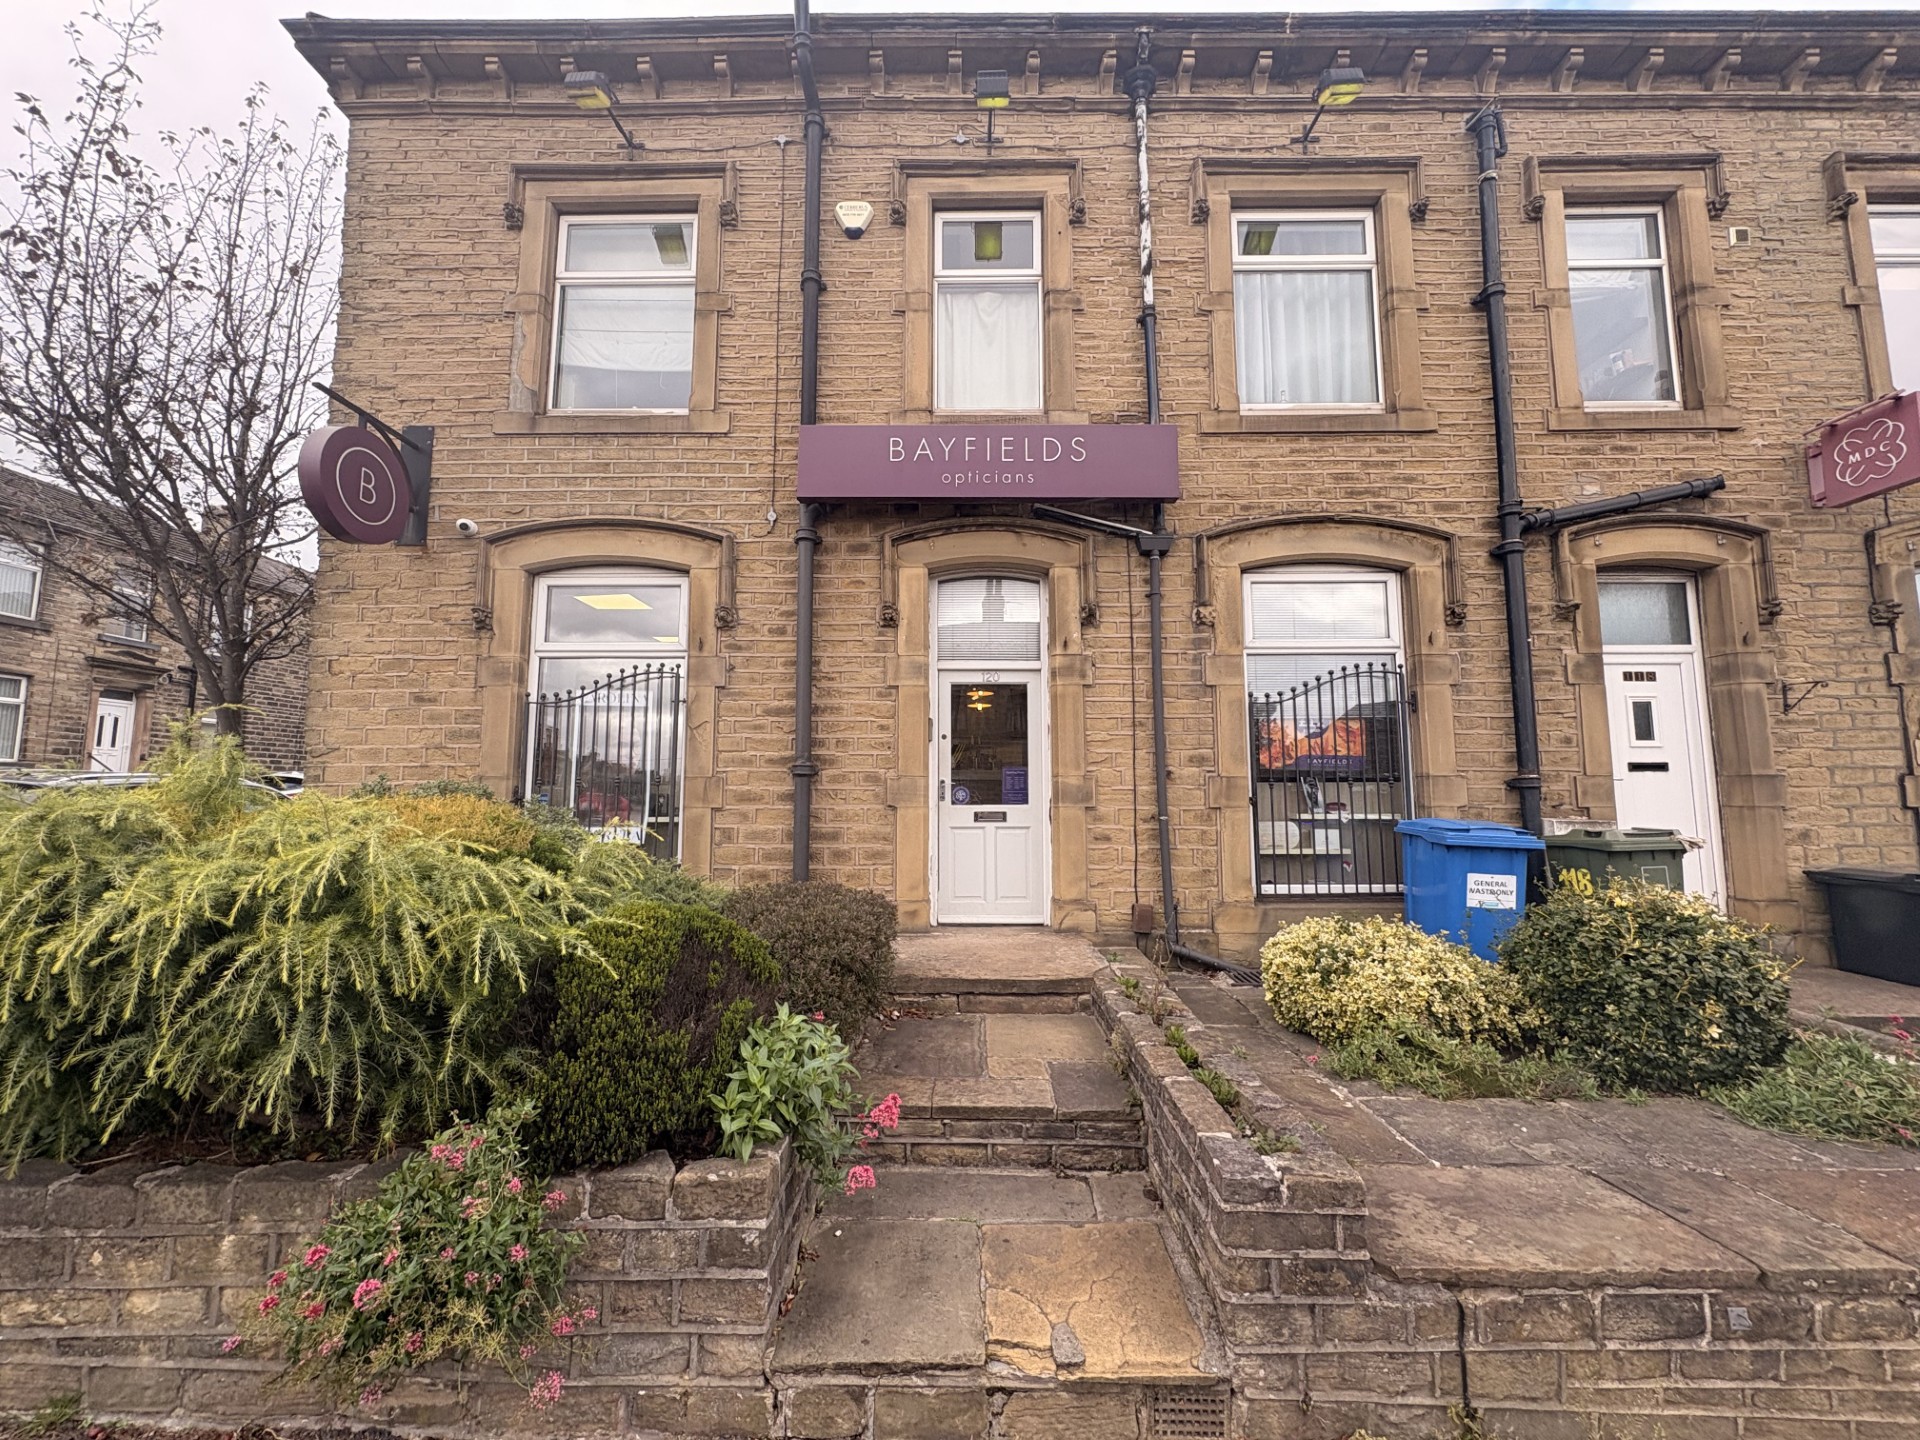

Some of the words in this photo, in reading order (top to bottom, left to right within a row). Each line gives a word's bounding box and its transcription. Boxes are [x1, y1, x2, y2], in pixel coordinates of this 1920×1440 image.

[889, 437, 1087, 462] BAYFIELDS
[1848, 440, 1891, 465] MDC
[359, 466, 377, 505] B
[941, 470, 1035, 487] opticians
[981, 671, 1000, 682] 120
[1624, 671, 1656, 681] 118
[1473, 880, 1508, 888] GENERAL
